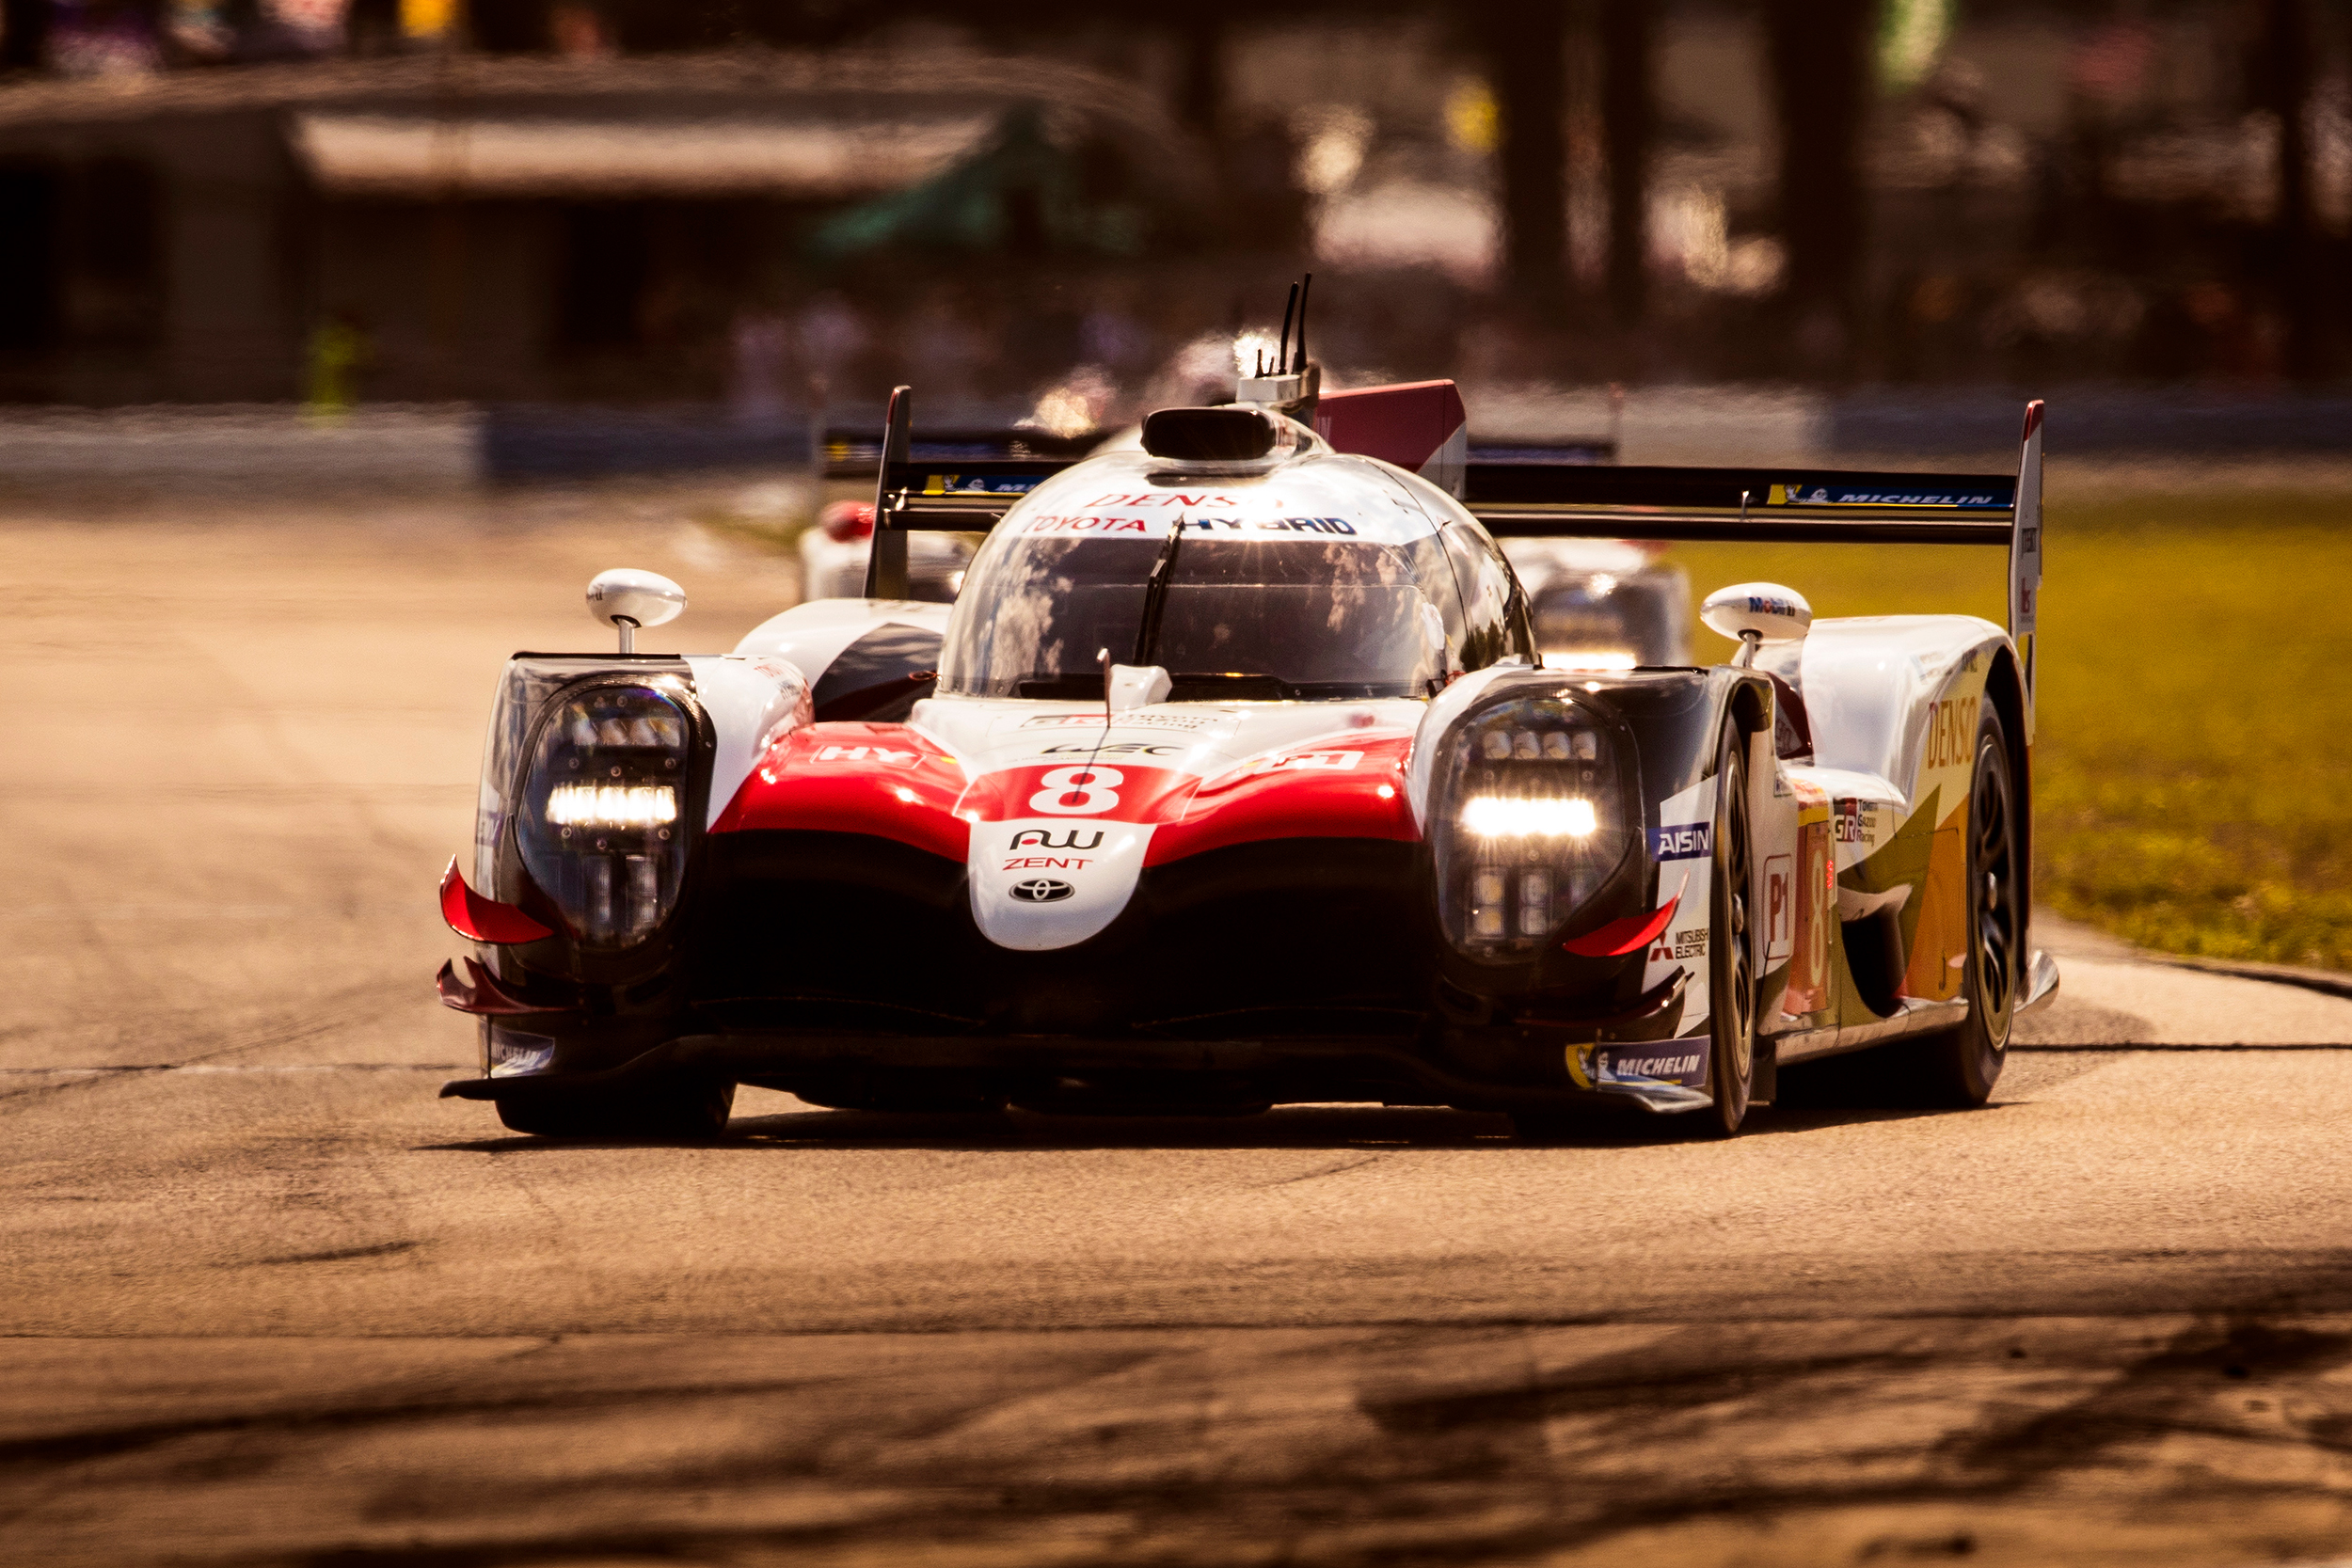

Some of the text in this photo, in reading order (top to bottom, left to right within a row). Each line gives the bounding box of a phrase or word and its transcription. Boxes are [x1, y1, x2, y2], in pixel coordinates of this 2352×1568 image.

[1084, 494, 1283, 509] DENS
[1838, 494, 1994, 505] MICHELIN
[1023, 515, 1147, 533] TOYOTA
[1928, 696, 1976, 769] DENSO
[819, 746, 918, 764] HY
[1041, 743, 1185, 756] WEC
[1029, 766, 1125, 816] 8
[1834, 815, 1857, 842] GR
[1658, 825, 1709, 855] AISIN
[1002, 857, 1094, 871] ZENT
[1809, 848, 1825, 988] 8
[1676, 943, 1707, 959] ELECTRIC
[1616, 1054, 1701, 1076] MICHELIN
